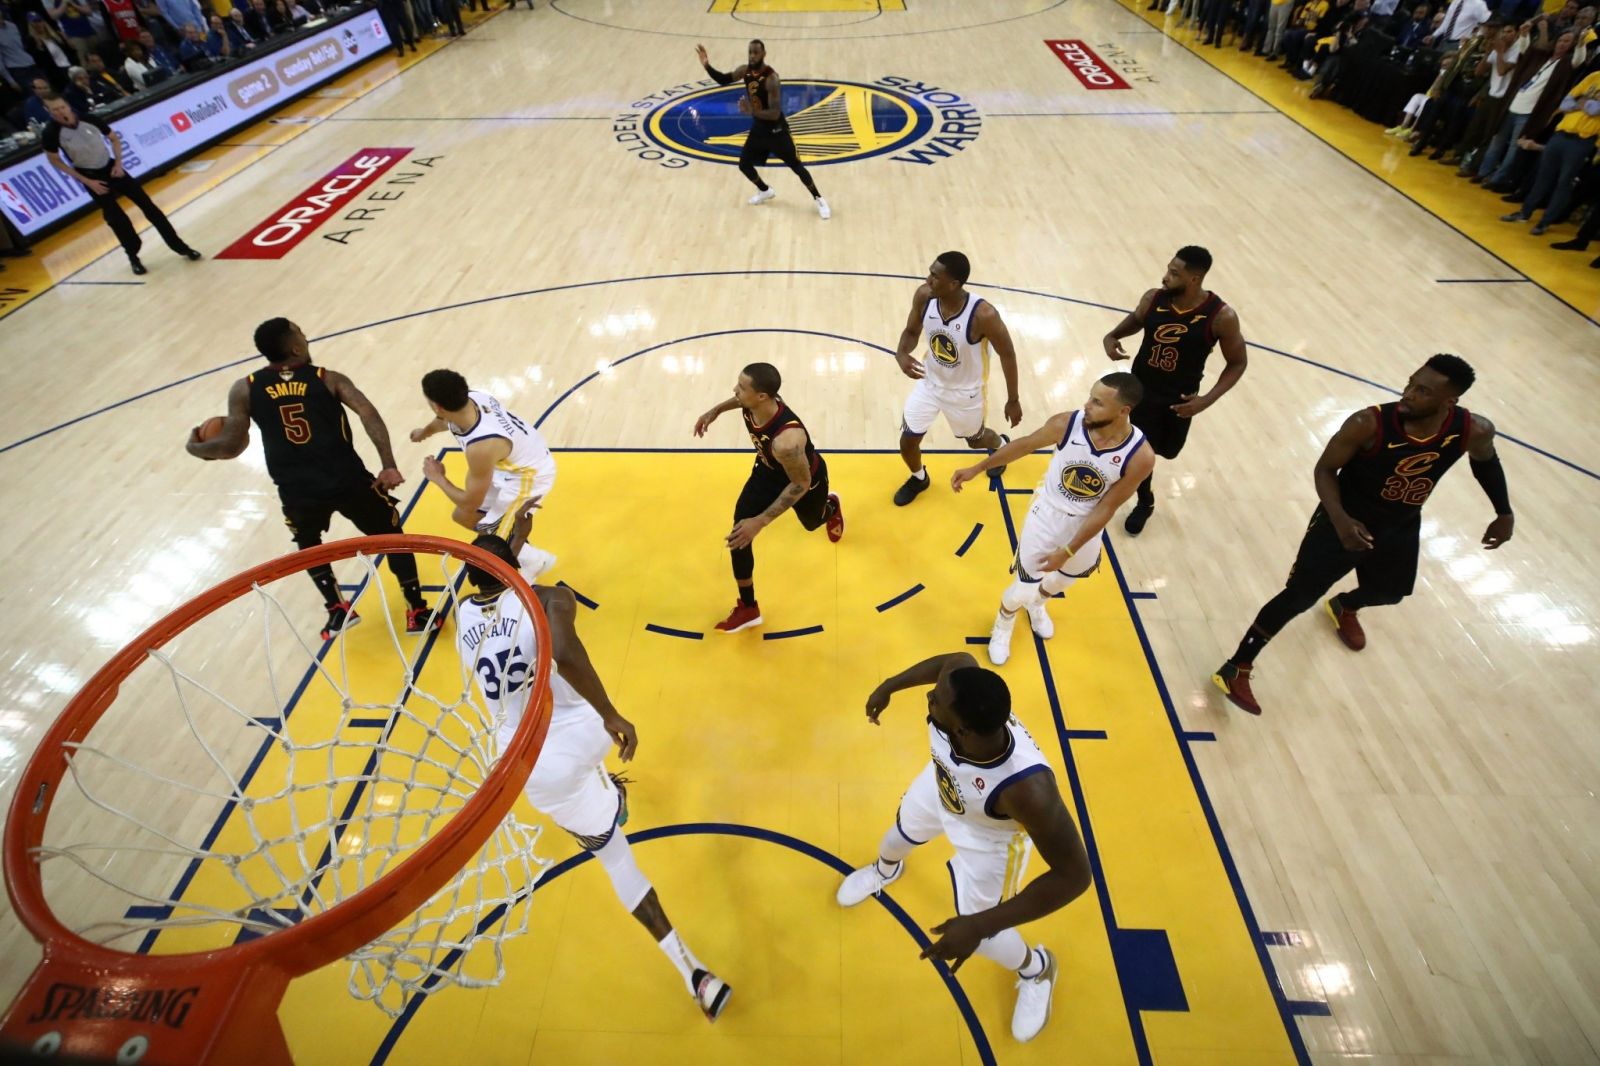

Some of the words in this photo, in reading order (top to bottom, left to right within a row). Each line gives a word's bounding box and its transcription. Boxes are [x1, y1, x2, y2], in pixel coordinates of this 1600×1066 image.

[1055, 43, 1114, 85] ORACLE
[1097, 43, 1160, 82] ARENA
[237, 80, 265, 104] game
[260, 74, 272, 89] 2
[631, 79, 717, 108] STATE
[874, 76, 982, 165] WARRIORS
[613, 113, 689, 168] GOLDEN
[9, 165, 72, 217] NBA
[251, 154, 391, 247] ORACLE
[323, 155, 445, 245] ARENA
[946, 342, 953, 352] 5
[1154, 323, 1189, 343] C
[1148, 344, 1179, 371] 13
[265, 381, 307, 399] SMITH
[279, 403, 311, 444] 5
[1082, 474, 1100, 487] 30
[1394, 451, 1440, 476] C
[1380, 476, 1434, 505] 32
[463, 617, 517, 650] DURANT
[476, 645, 534, 700] 35
[27, 982, 200, 1029] SPALDING
